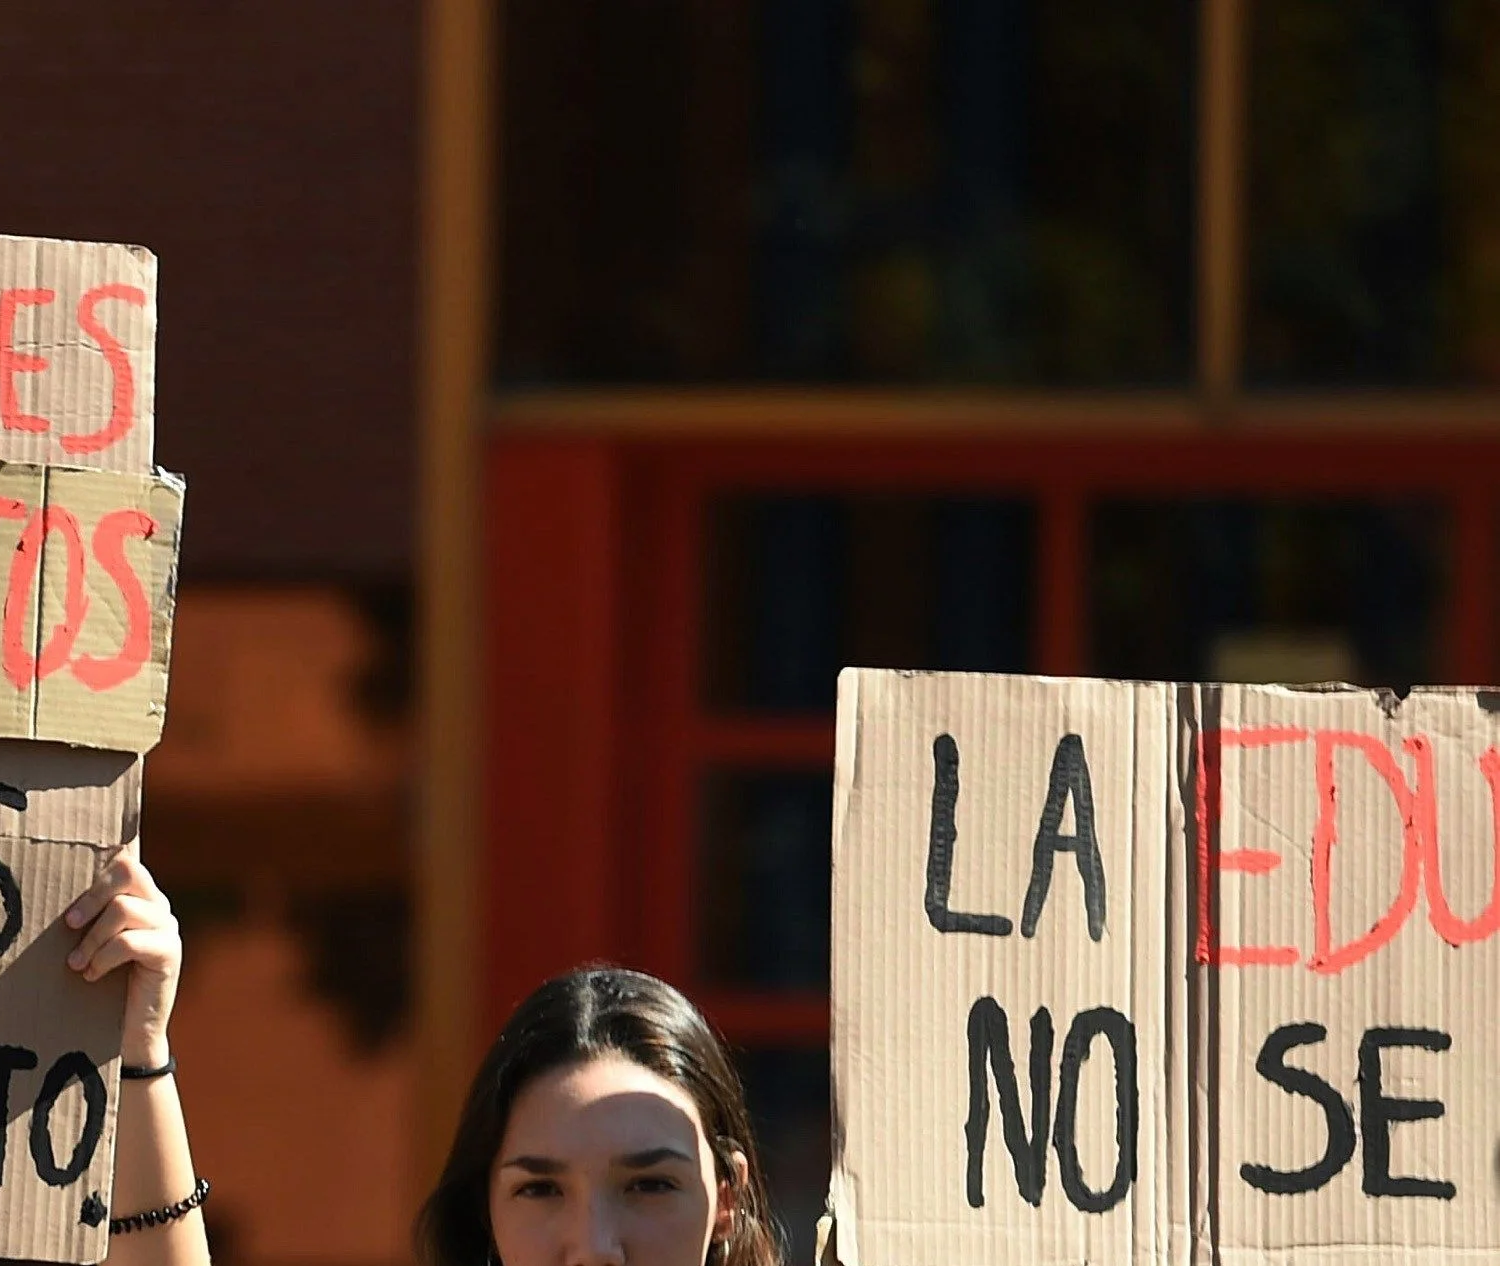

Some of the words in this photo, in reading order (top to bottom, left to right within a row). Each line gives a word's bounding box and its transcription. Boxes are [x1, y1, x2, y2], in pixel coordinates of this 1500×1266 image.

[925, 733, 1105, 942] LA
[1195, 725, 1500, 976] EDU
[964, 996, 1139, 1213] NO
[1240, 1021, 1456, 1200] SE
